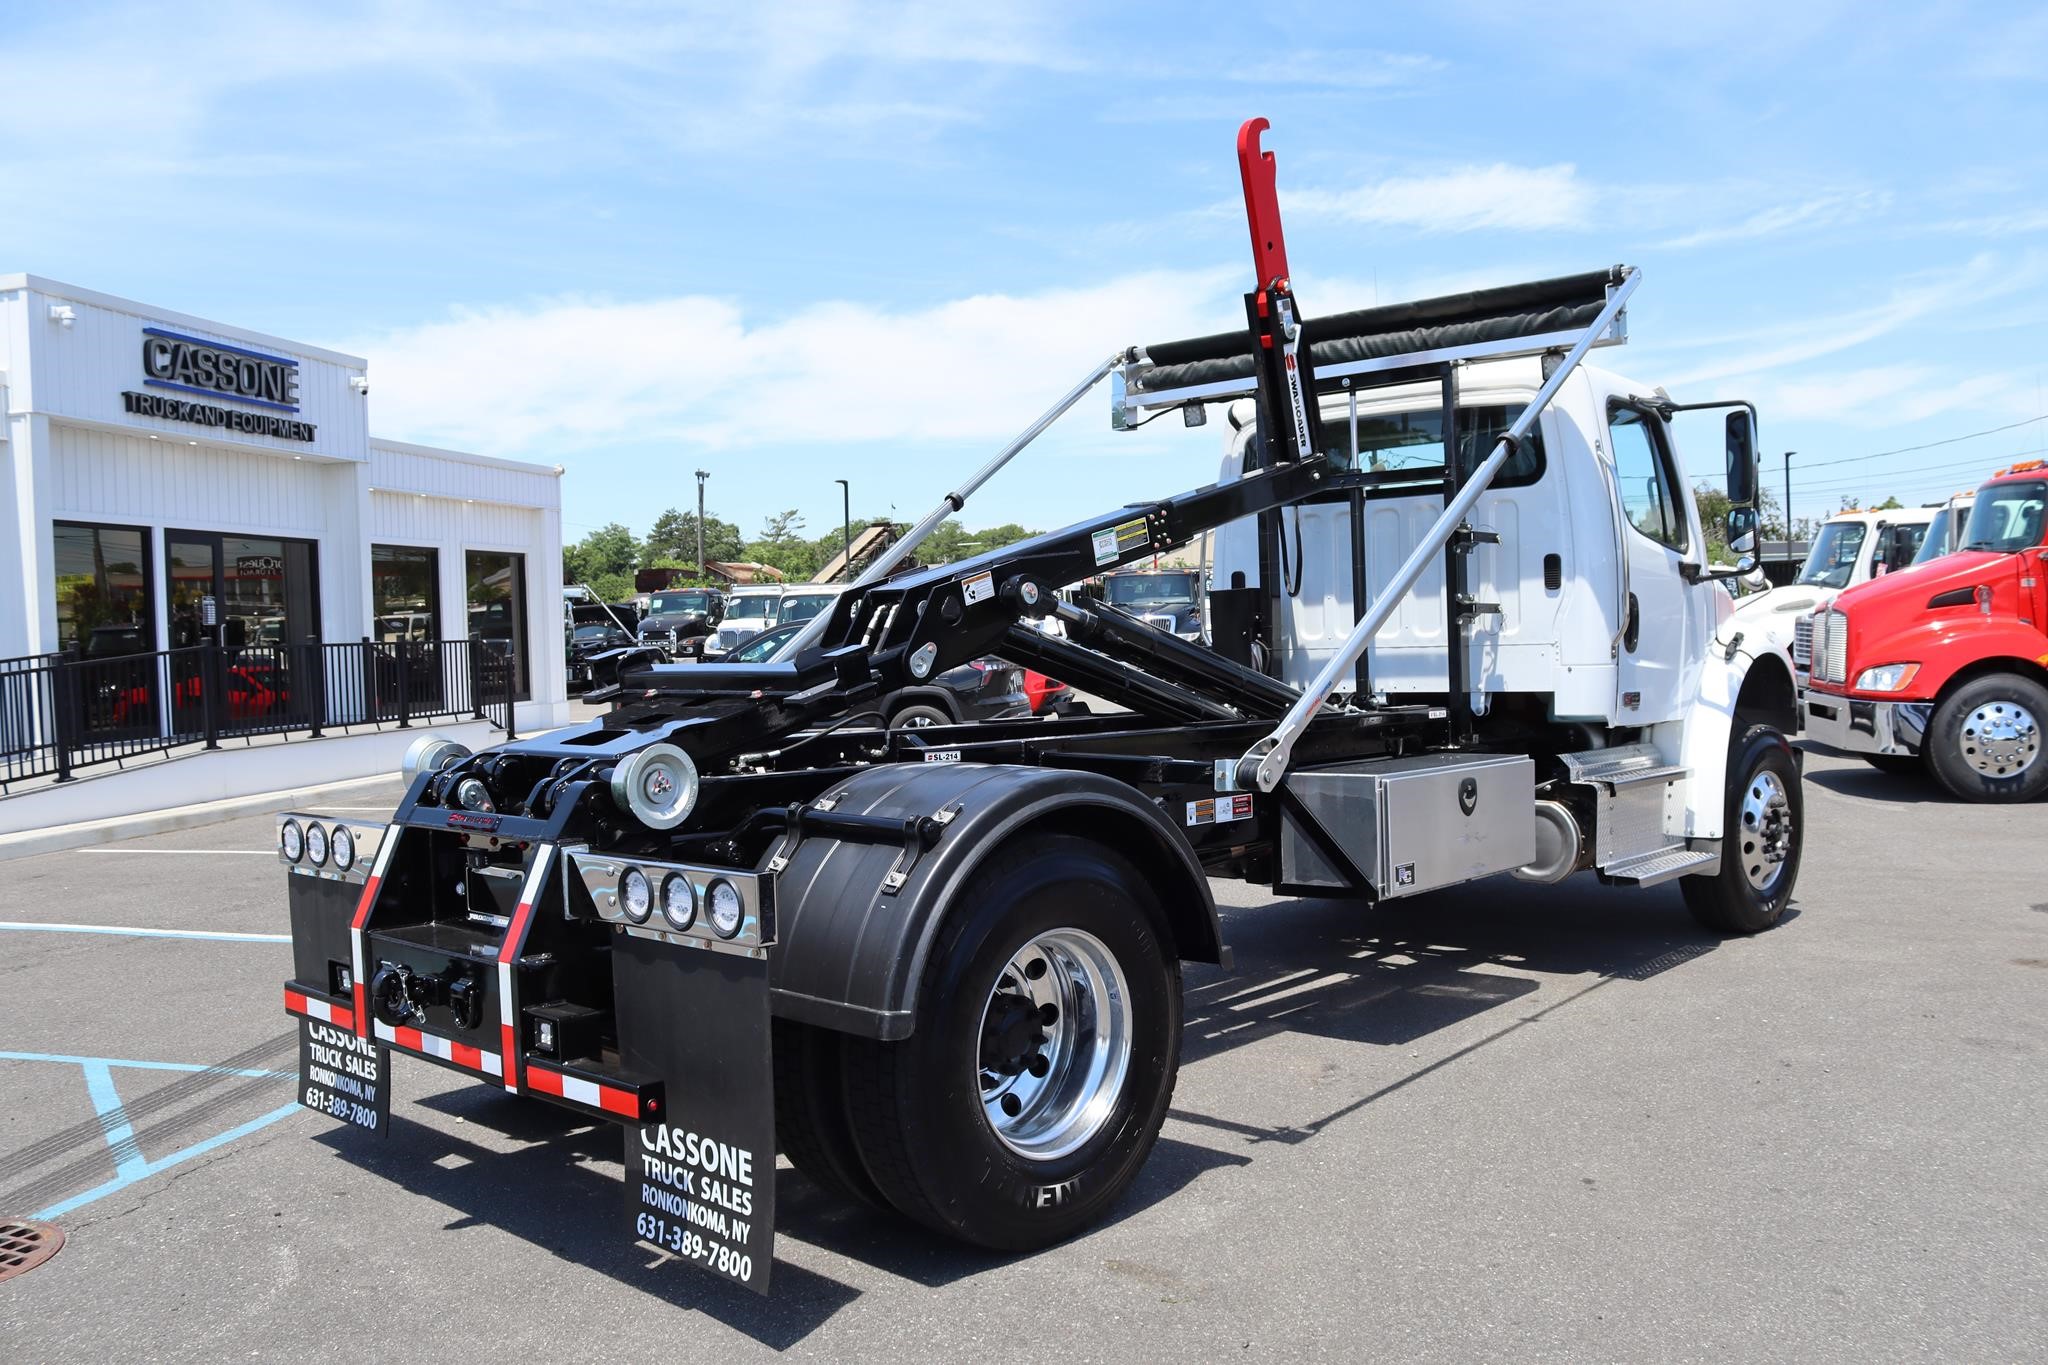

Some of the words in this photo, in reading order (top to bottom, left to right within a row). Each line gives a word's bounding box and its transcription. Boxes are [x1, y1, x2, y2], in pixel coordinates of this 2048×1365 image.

[143, 338, 300, 404] CASSONE
[121, 391, 193, 421] TRUCK
[192, 403, 226, 427] AND
[226, 410, 317, 442] EQUIPMENT
[1289, 373, 1307, 448] SWAPLOADER
[309, 1042, 343, 1070] TRUCK
[345, 1054, 377, 1081] SALES
[309, 1065, 364, 1100] RONKONKOMA,
[364, 1083, 376, 1102] NY
[306, 1087, 377, 1130] 631-389-7800
[640, 1123, 753, 1187] CASSONE
[641, 1153, 695, 1195] TRUCK
[700, 1176, 752, 1216] SALES
[642, 1183, 730, 1240] RONKONKOMA,
[732, 1219, 751, 1245] NY
[636, 1212, 752, 1282] 631-389-7800
